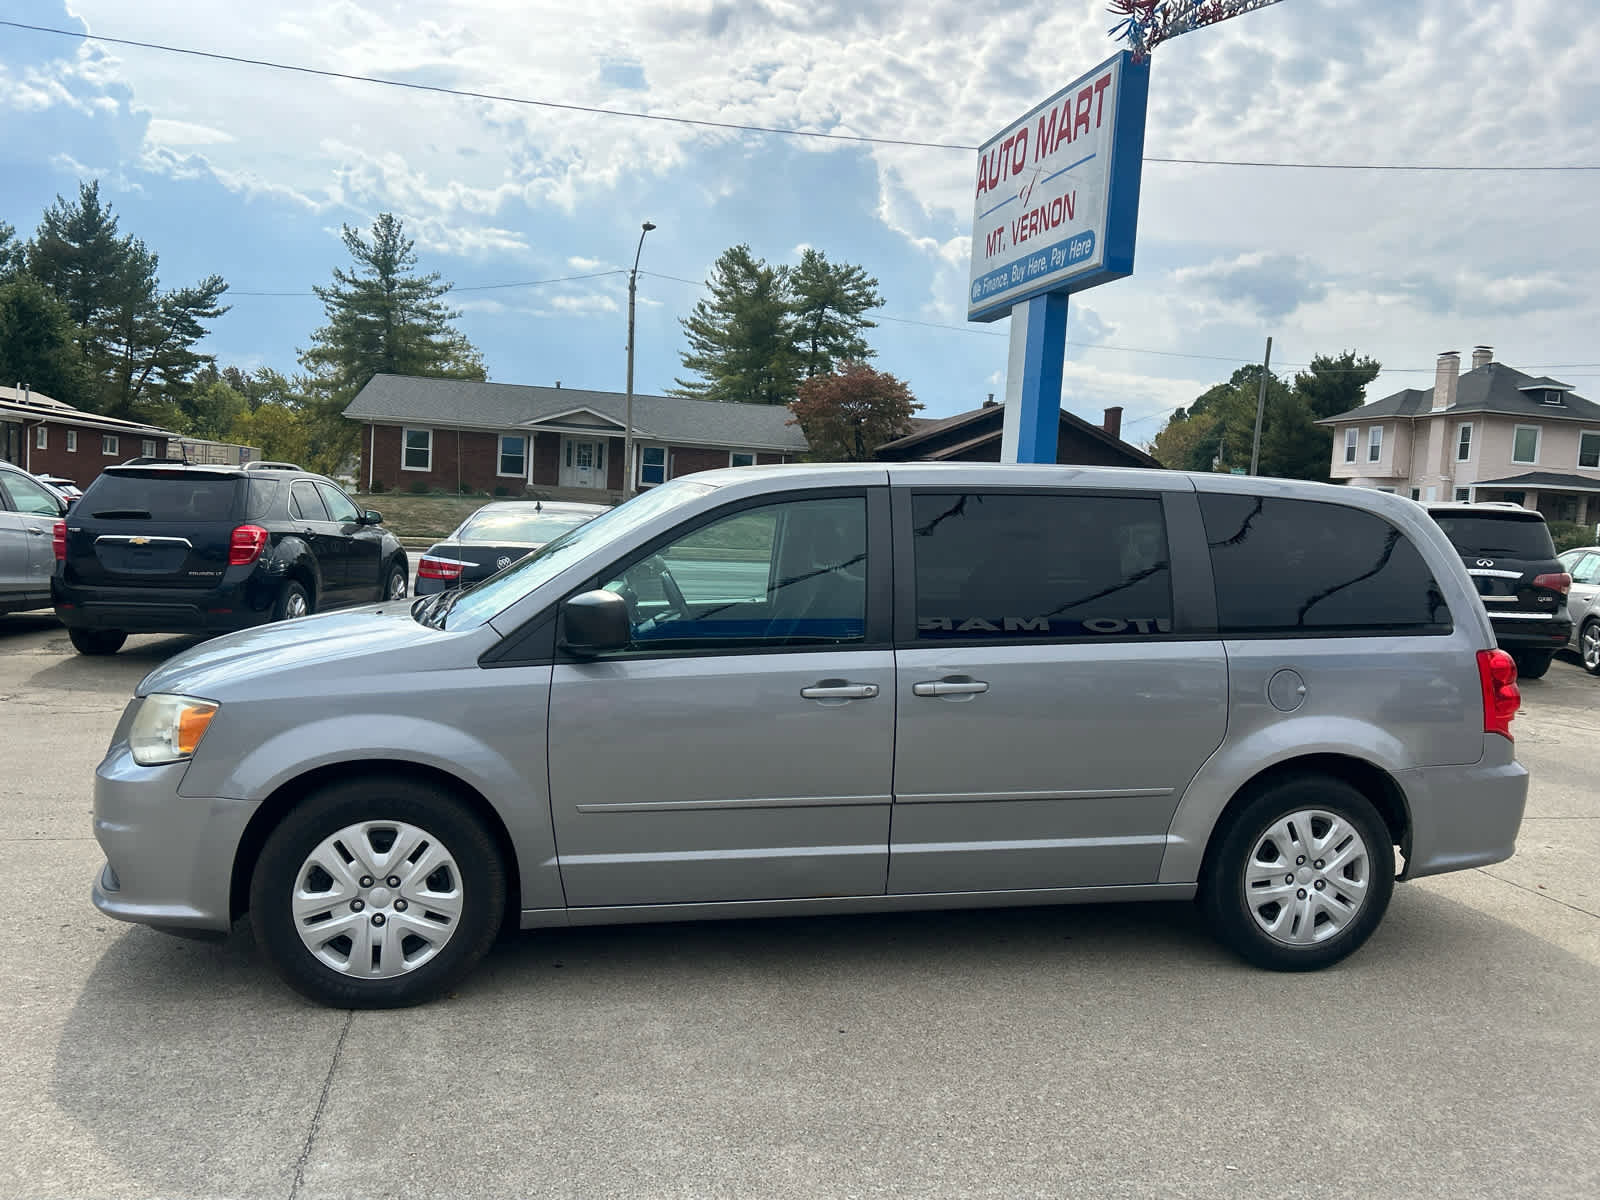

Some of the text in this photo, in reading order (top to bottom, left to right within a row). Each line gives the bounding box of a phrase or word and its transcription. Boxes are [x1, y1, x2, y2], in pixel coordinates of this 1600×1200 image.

[976, 72, 1111, 200] AUTO MART
[1019, 166, 1041, 208] of
[985, 190, 1076, 259] MT. VERNON
[982, 272, 1009, 295] Finance,
[1011, 263, 1026, 283] Buy
[1027, 254, 1048, 276] Here,
[1050, 247, 1066, 267] Pay
[1069, 237, 1092, 258] Here
